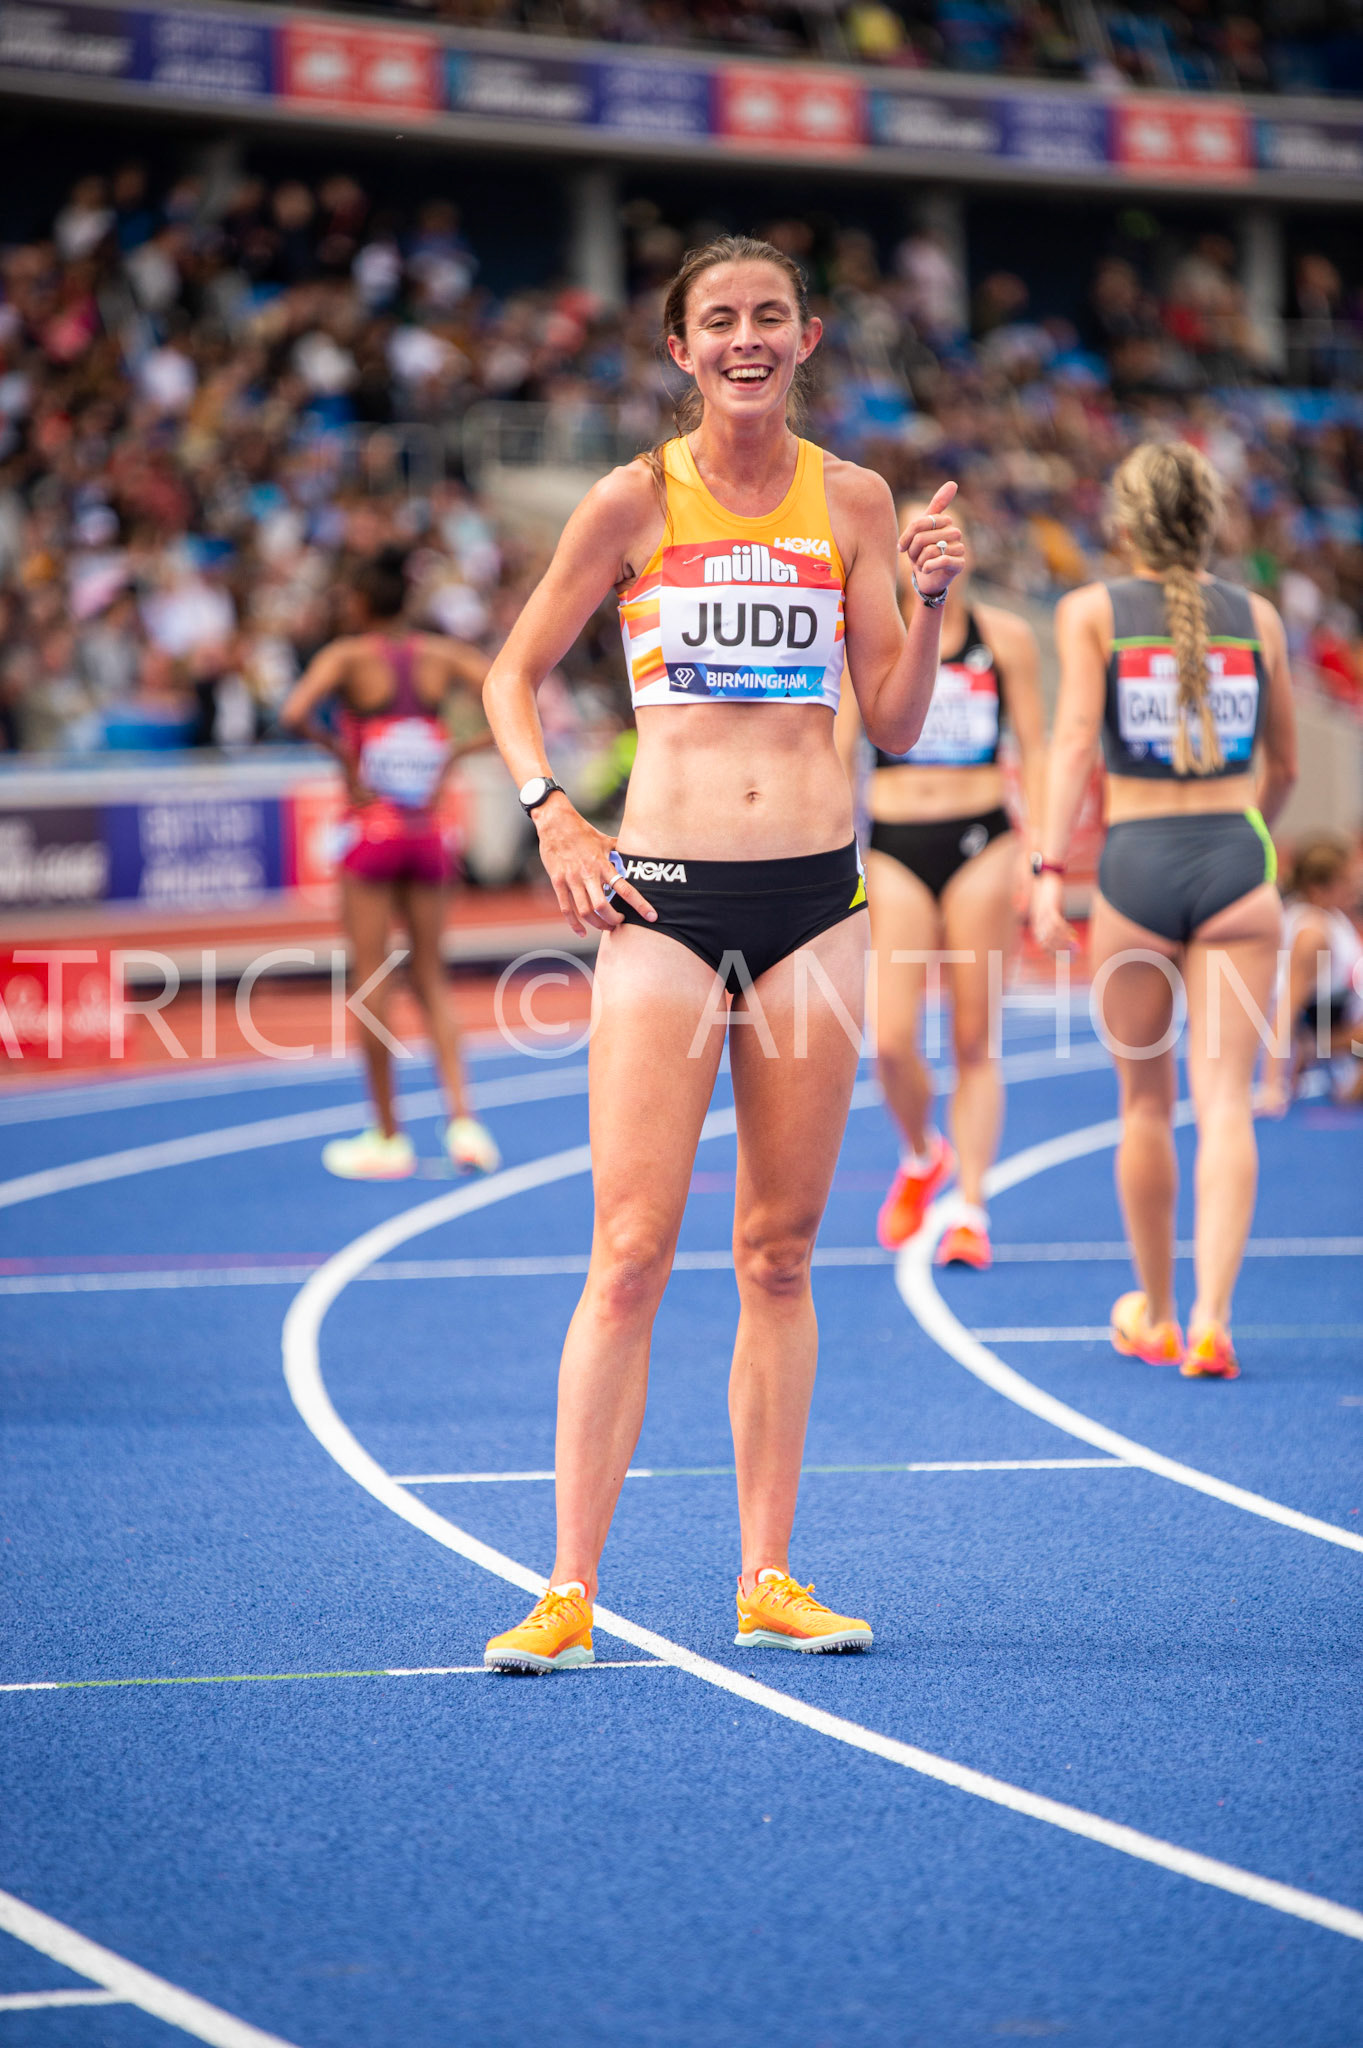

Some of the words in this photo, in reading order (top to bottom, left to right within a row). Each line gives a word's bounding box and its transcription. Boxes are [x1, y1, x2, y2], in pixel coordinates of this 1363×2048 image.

[774, 537, 831, 558] HOKA
[704, 544, 799, 583] müller
[681, 602, 818, 649] JUDD
[706, 671, 807, 689] BIRMINGHAM
[1129, 690, 1254, 724] GALRDO
[626, 860, 687, 883] HOKA
